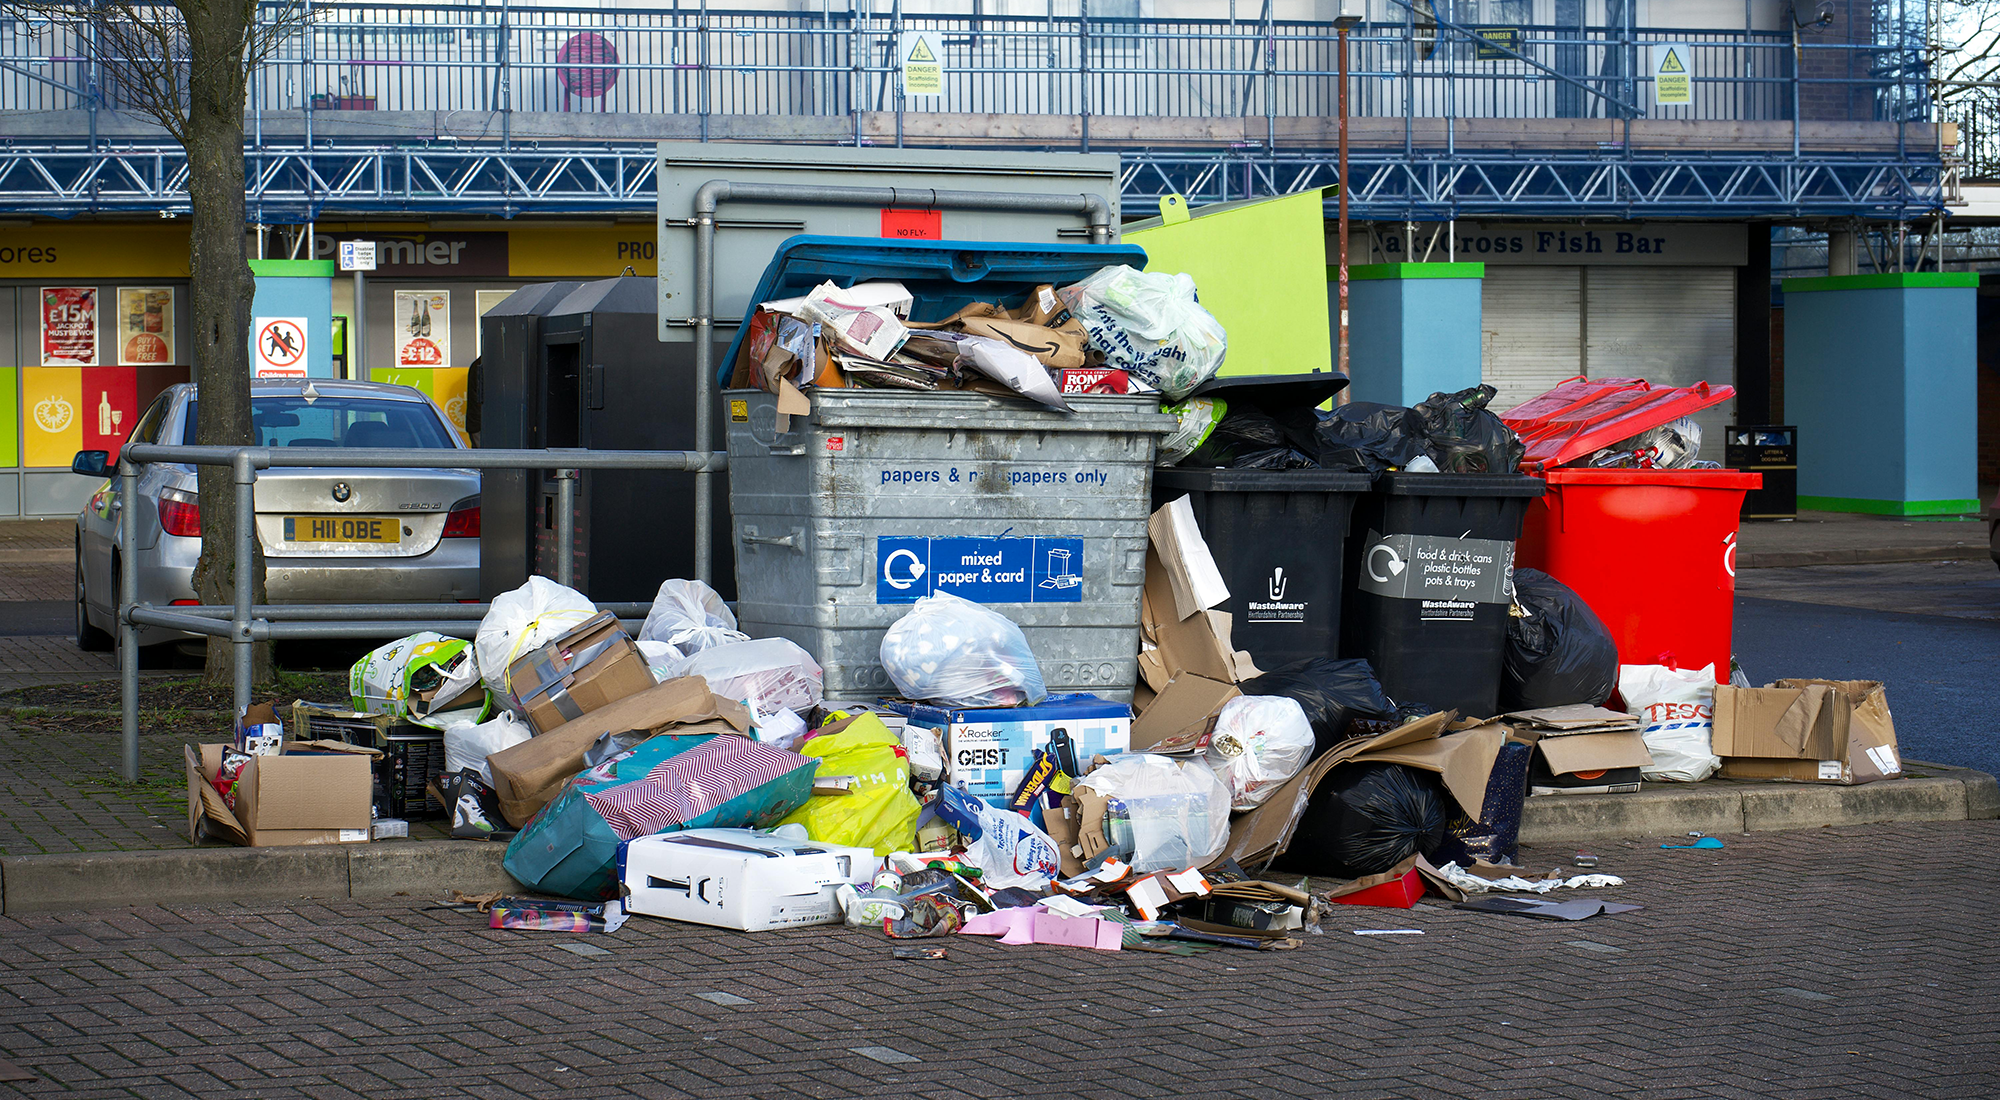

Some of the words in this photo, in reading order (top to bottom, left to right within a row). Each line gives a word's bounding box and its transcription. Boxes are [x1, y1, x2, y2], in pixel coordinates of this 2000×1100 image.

[315, 235, 466, 265] Pmier
[617, 241, 657, 260] PRO
[1439, 231, 1524, 253] Cross
[1537, 230, 1603, 254] Fish
[1616, 232, 1666, 254] Bar
[56, 322, 88, 330] JACKPOT
[136, 344, 151, 352] GET
[1090, 326, 1116, 355] that
[136, 352, 158, 361] FREE
[408, 346, 435, 361] £12
[881, 470, 940, 485] papers
[948, 467, 960, 482] &
[969, 469, 1067, 486] nspapers
[1075, 469, 1108, 487] only
[342, 521, 382, 539] OBE
[961, 551, 1003, 566] mixed
[1416, 547, 1437, 560] food
[1439, 549, 1447, 560] &
[1472, 555, 1493, 564] cans
[1423, 560, 1450, 575] plastic
[1452, 562, 1481, 576] bottles
[938, 570, 980, 587] paper
[981, 569, 993, 582] &
[994, 568, 1025, 584] card
[1425, 575, 1443, 588] pots
[1444, 576, 1452, 586] &
[1453, 576, 1476, 590] trays
[957, 748, 1010, 767] GEIST
